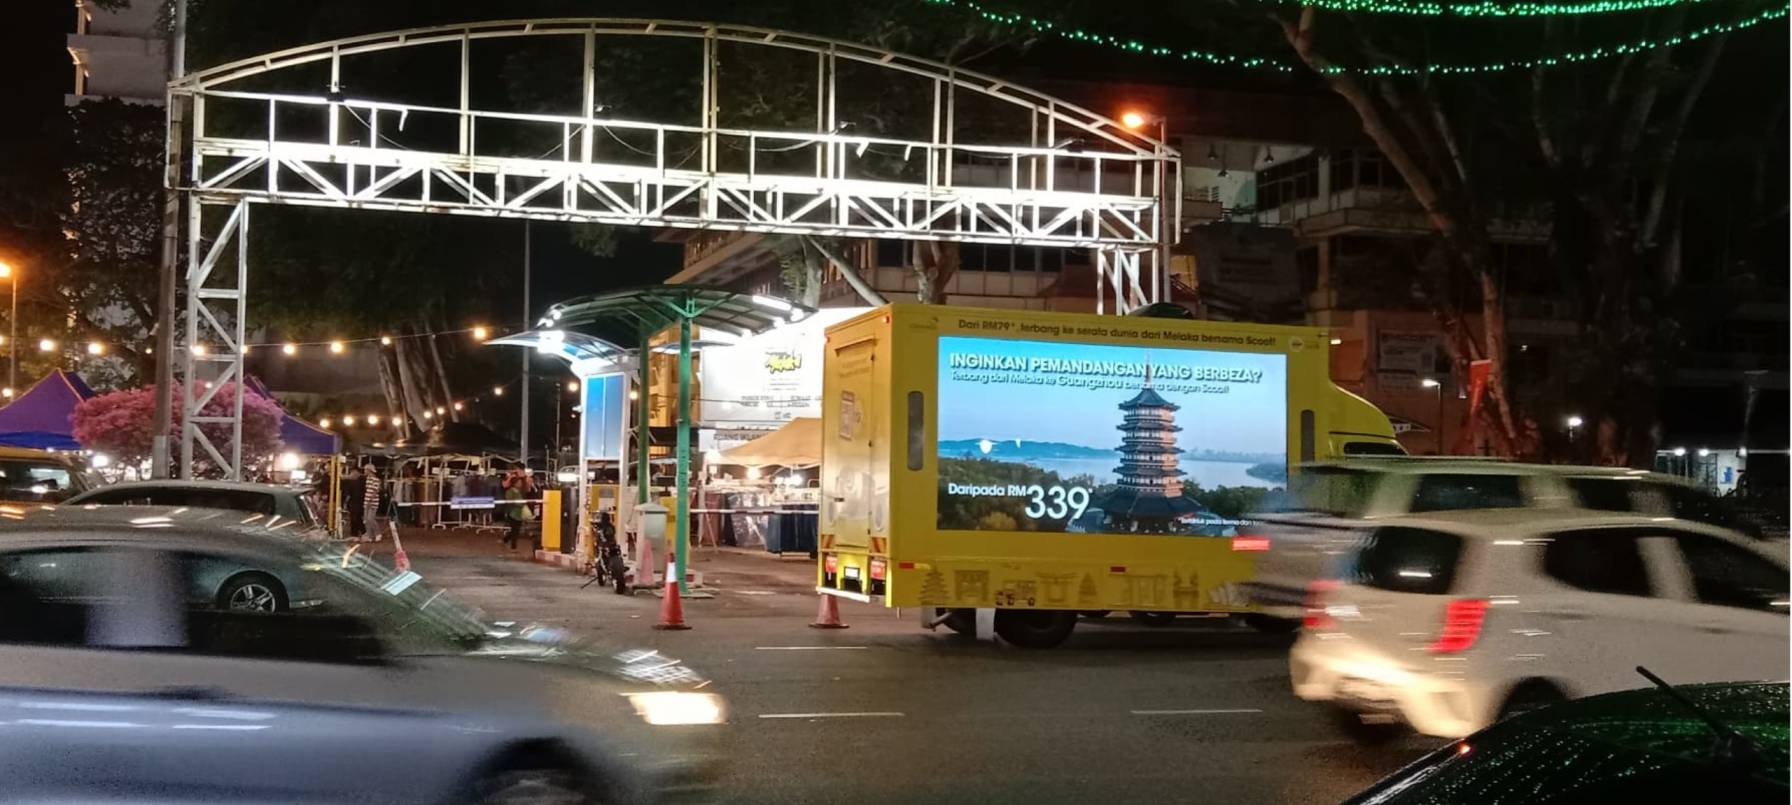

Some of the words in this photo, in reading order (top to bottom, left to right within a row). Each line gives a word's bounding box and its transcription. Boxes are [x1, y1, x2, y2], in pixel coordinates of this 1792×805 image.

[959, 319, 979, 330] Dari
[1020, 323, 1060, 336] terbang
[1062, 325, 1074, 335] ke
[1111, 329, 1139, 339] dunia
[1141, 330, 1161, 340] dari
[1163, 331, 1199, 342] Melaka
[1201, 333, 1244, 345] bersama
[950, 352, 1028, 371] INGINKAN
[1031, 356, 1146, 378] PEMANDANGAN
[1149, 363, 1193, 381] YANG
[1195, 366, 1263, 384] BERBEZA?
[1059, 375, 1124, 391] Guangzhou
[948, 483, 1005, 498] Daripada
